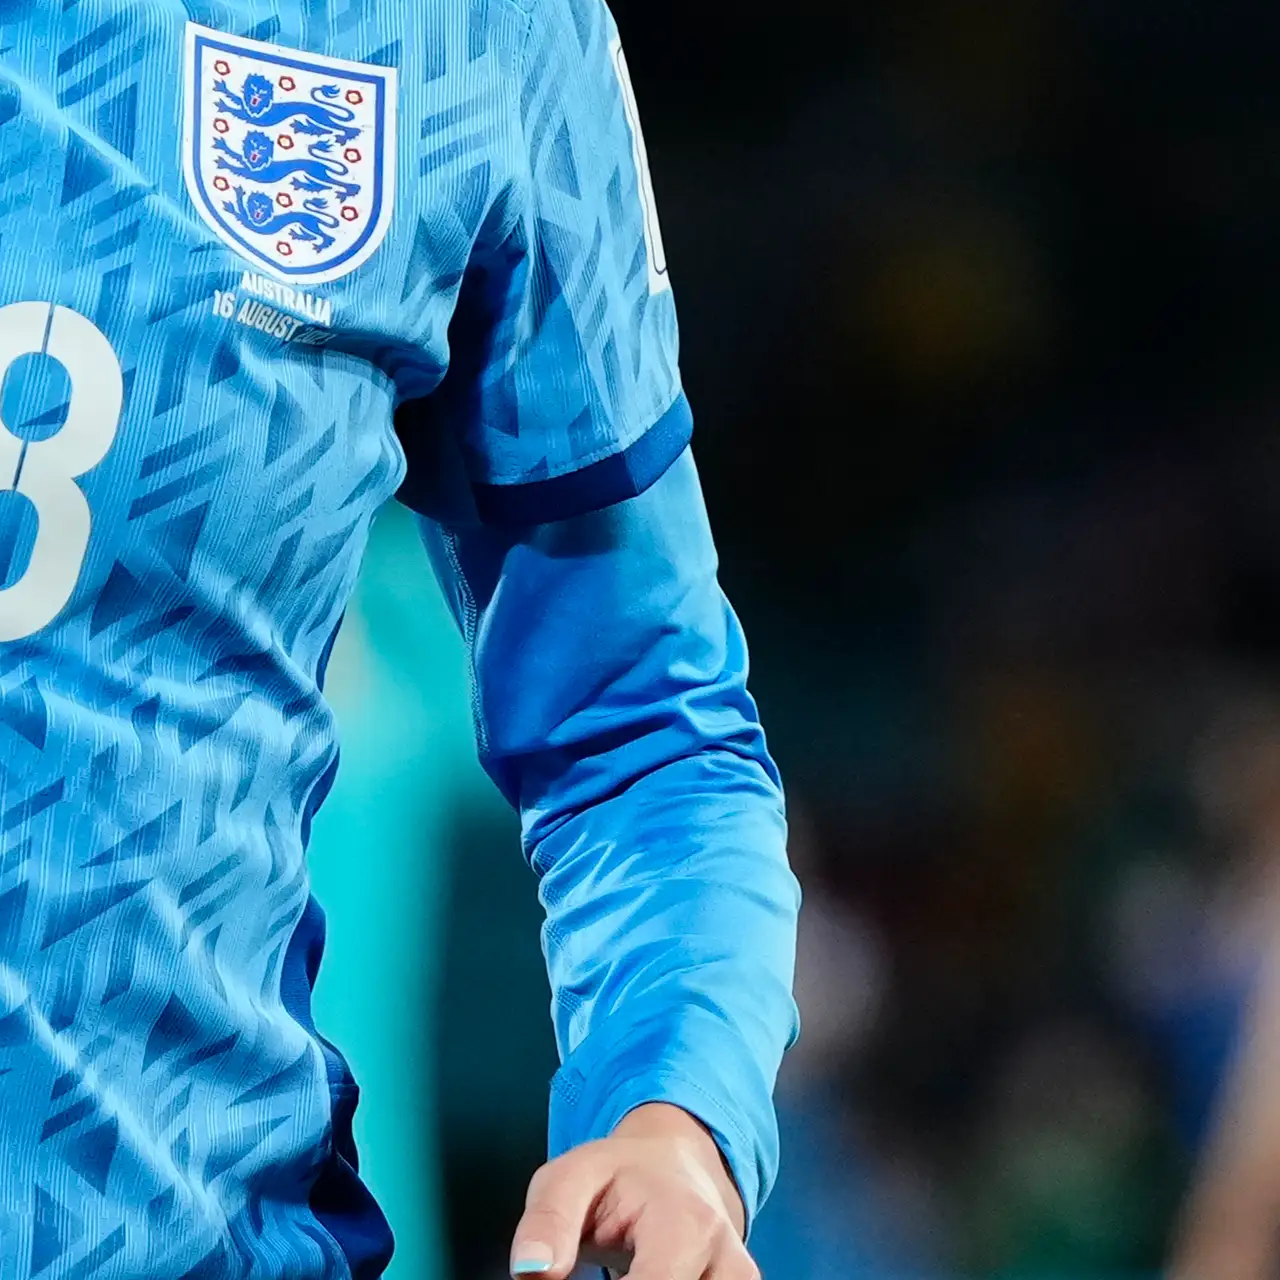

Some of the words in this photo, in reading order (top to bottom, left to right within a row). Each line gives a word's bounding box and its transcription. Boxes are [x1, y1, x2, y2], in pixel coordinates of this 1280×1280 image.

[213, 290, 235, 318] 16
[238, 299, 303, 341] AUGUST
[242, 271, 332, 326] AUSTRALIA
